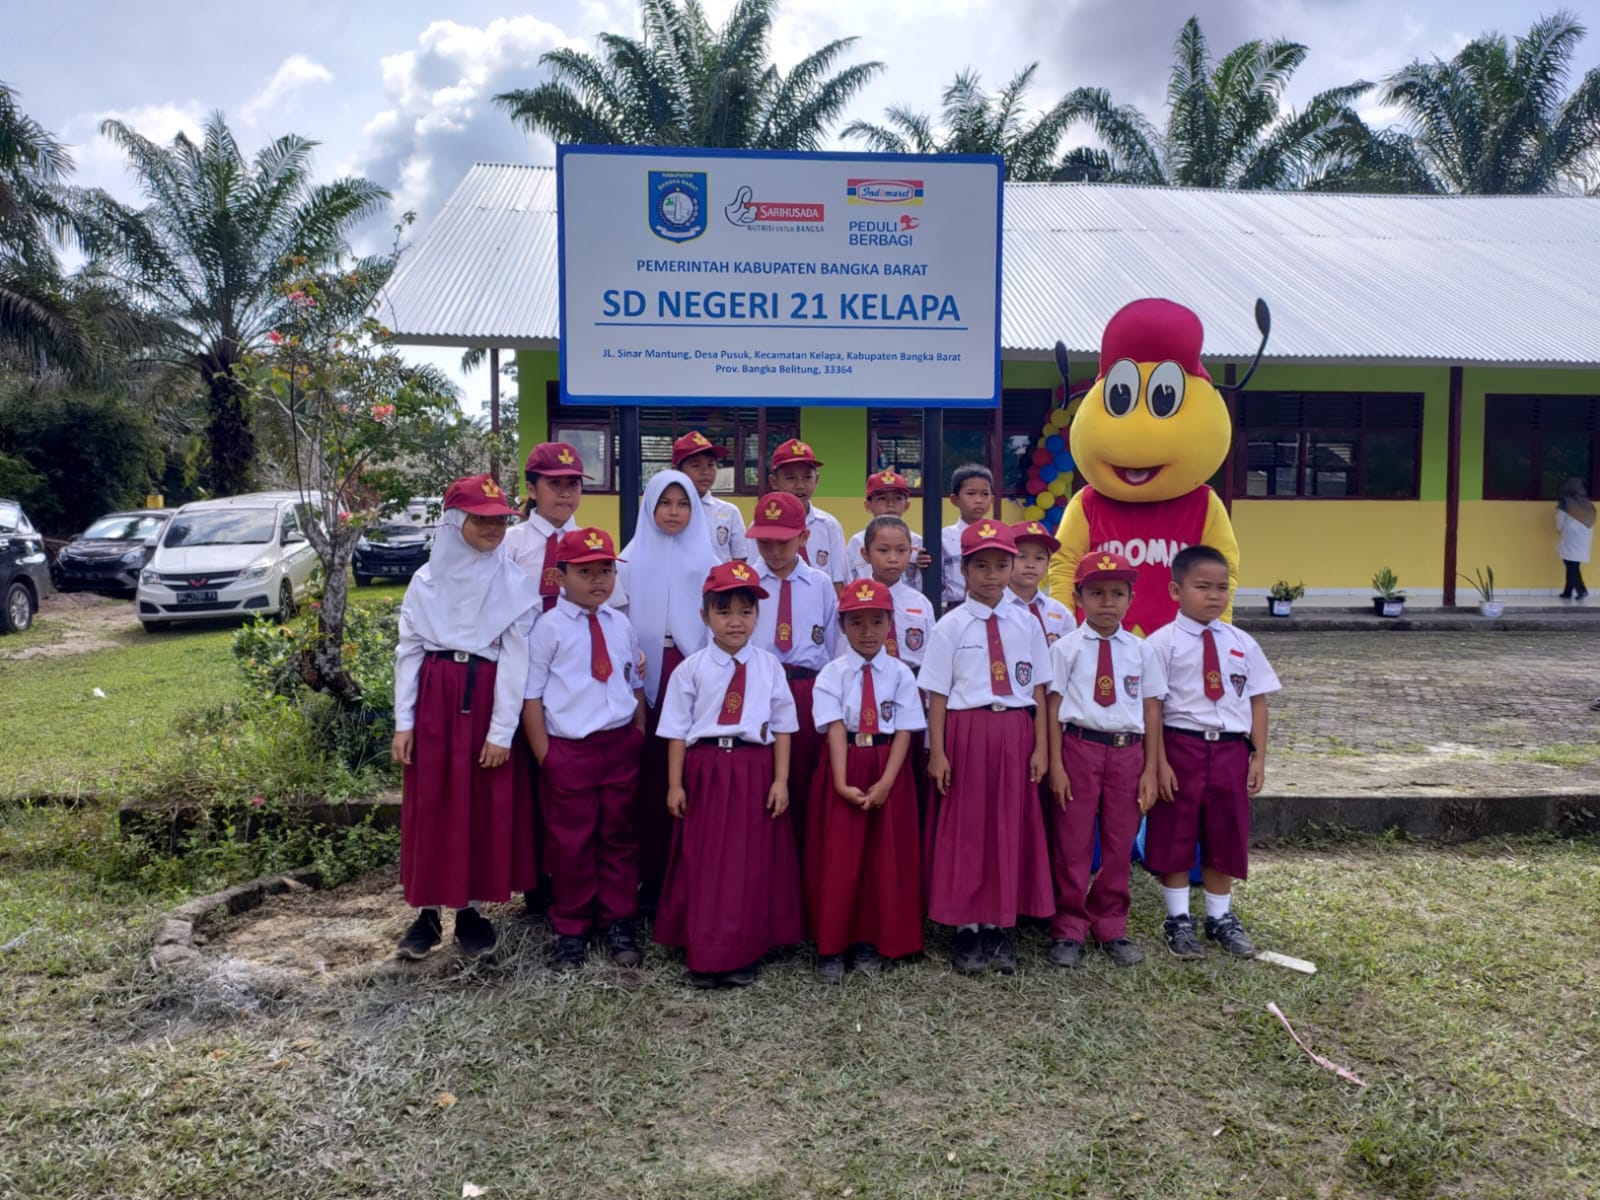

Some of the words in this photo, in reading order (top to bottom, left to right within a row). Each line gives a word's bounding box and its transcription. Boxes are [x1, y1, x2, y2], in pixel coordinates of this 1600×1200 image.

[760, 205, 819, 218] SARIHUSADA
[848, 221, 898, 232] PEDULI
[848, 233, 913, 247] BERBAGI
[636, 259, 730, 274] PEMERINTAH
[733, 261, 817, 275] KABUPATEN
[820, 263, 880, 276] BANGKA
[883, 264, 929, 276] BARAT
[602, 289, 647, 317] SD
[658, 290, 779, 319] NEGERI
[790, 292, 828, 320] 21
[840, 293, 961, 321] KELAPA
[602, 349, 616, 358] JL.
[617, 349, 643, 358] Sinar
[645, 350, 693, 360] Mantung,
[694, 350, 719, 360] Desa
[720, 351, 753, 361] Pusuk,
[754, 350, 808, 360] Kecamatan
[809, 352, 846, 362] Kelapa,
[846, 352, 898, 363] Kabupaten
[900, 352, 935, 363] Bangka
[936, 353, 962, 362] Barat
[715, 364, 741, 374] Prov.
[742, 365, 777, 375] Bangka
[779, 366, 822, 376] Belitung,
[823, 366, 853, 375] 33364
